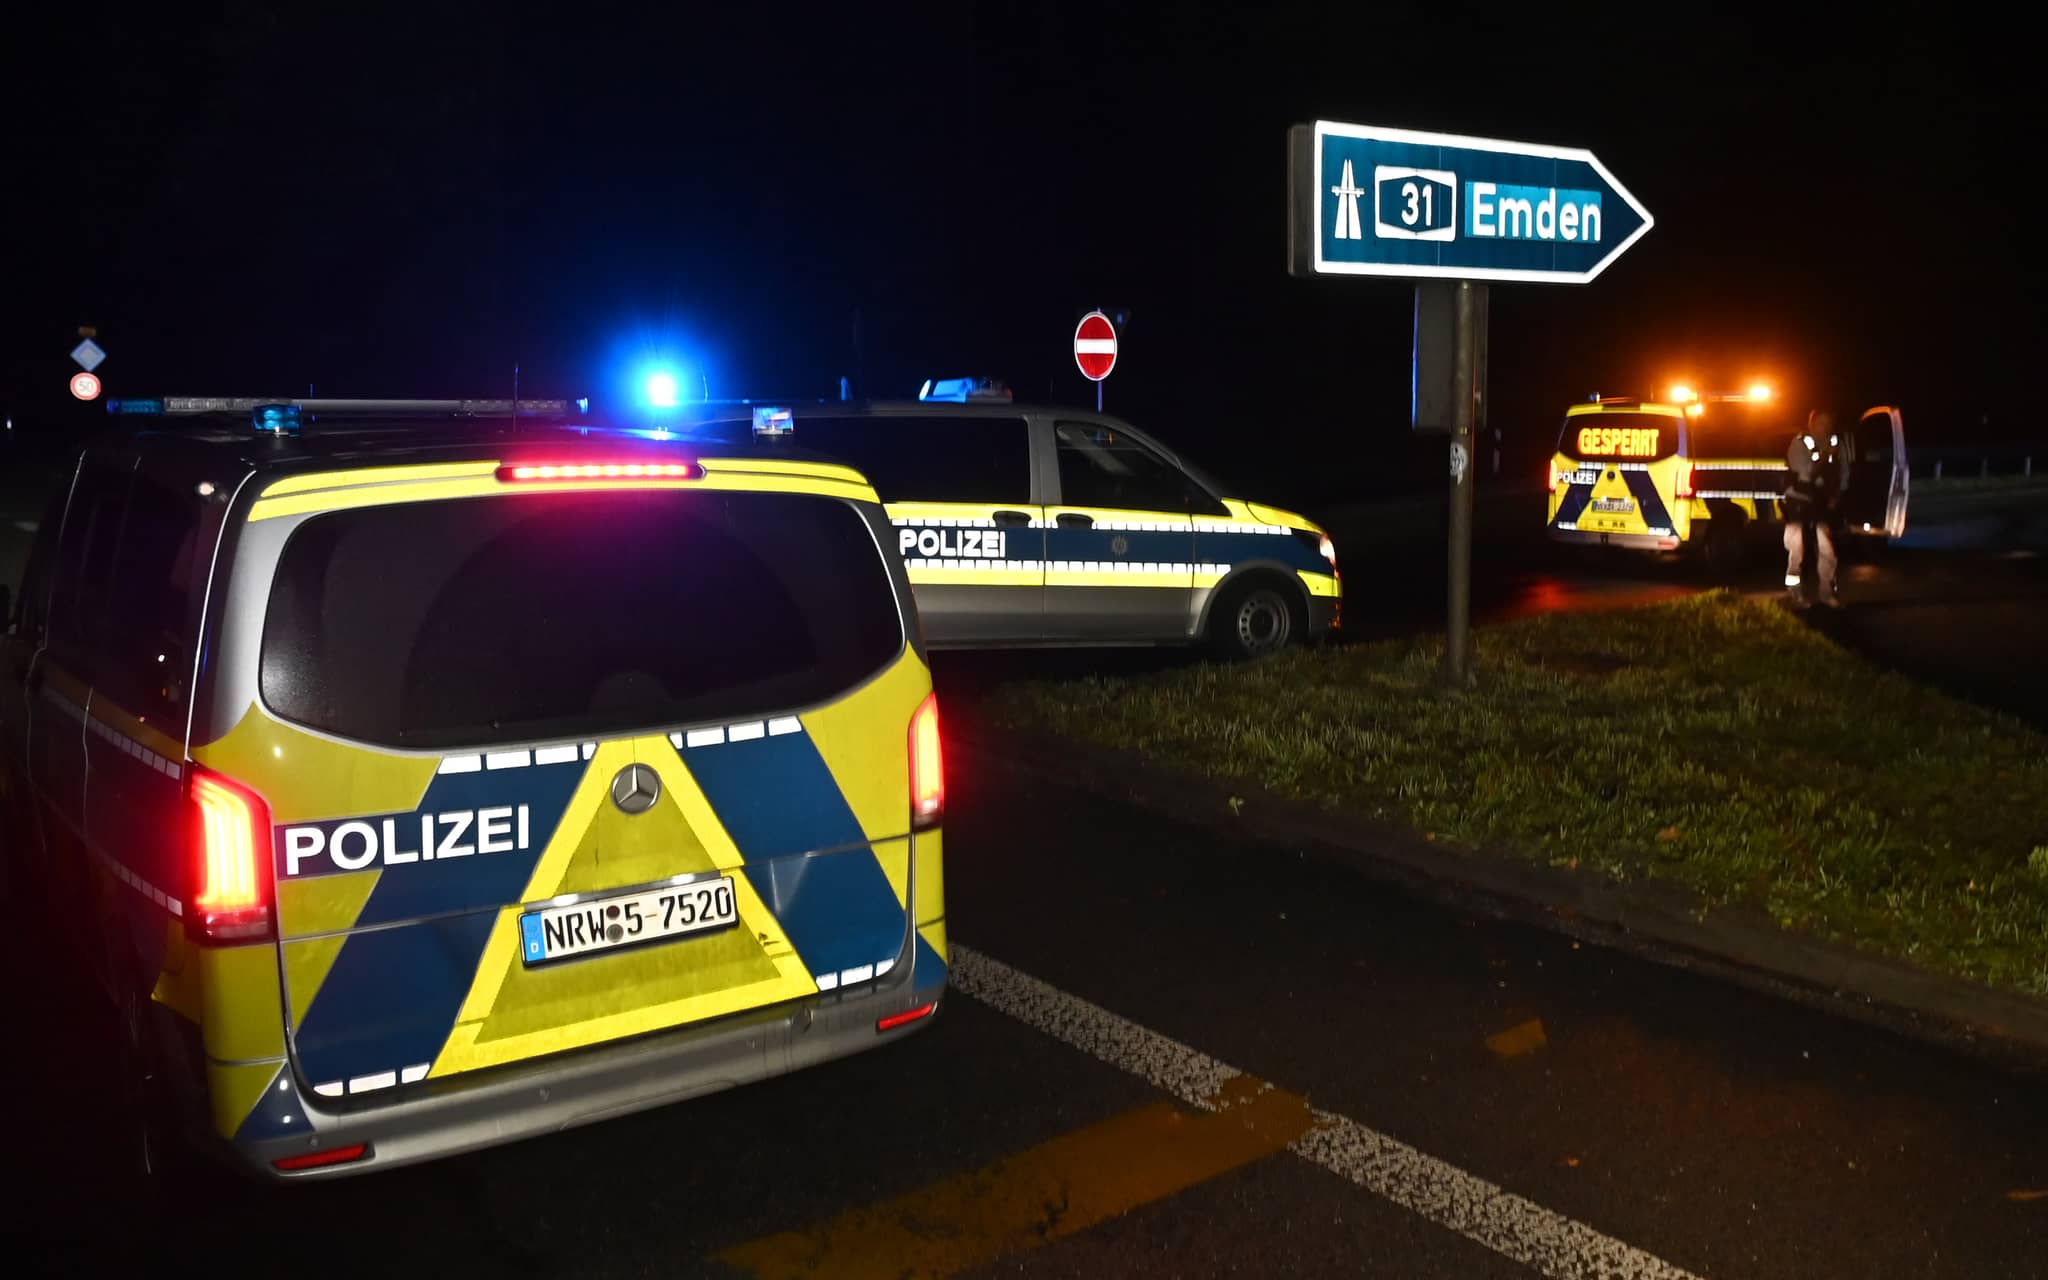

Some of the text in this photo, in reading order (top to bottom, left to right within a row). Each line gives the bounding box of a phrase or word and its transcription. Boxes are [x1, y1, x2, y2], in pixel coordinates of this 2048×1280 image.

[1401, 182, 1601, 242] 31 Emden
[1578, 428, 1659, 456] GESPERRT
[1557, 471, 1596, 485] POLIZEI
[899, 529, 1006, 558] POLIZEI
[284, 803, 530, 876] POLIZEI
[543, 886, 733, 953] NRW 5-7520
